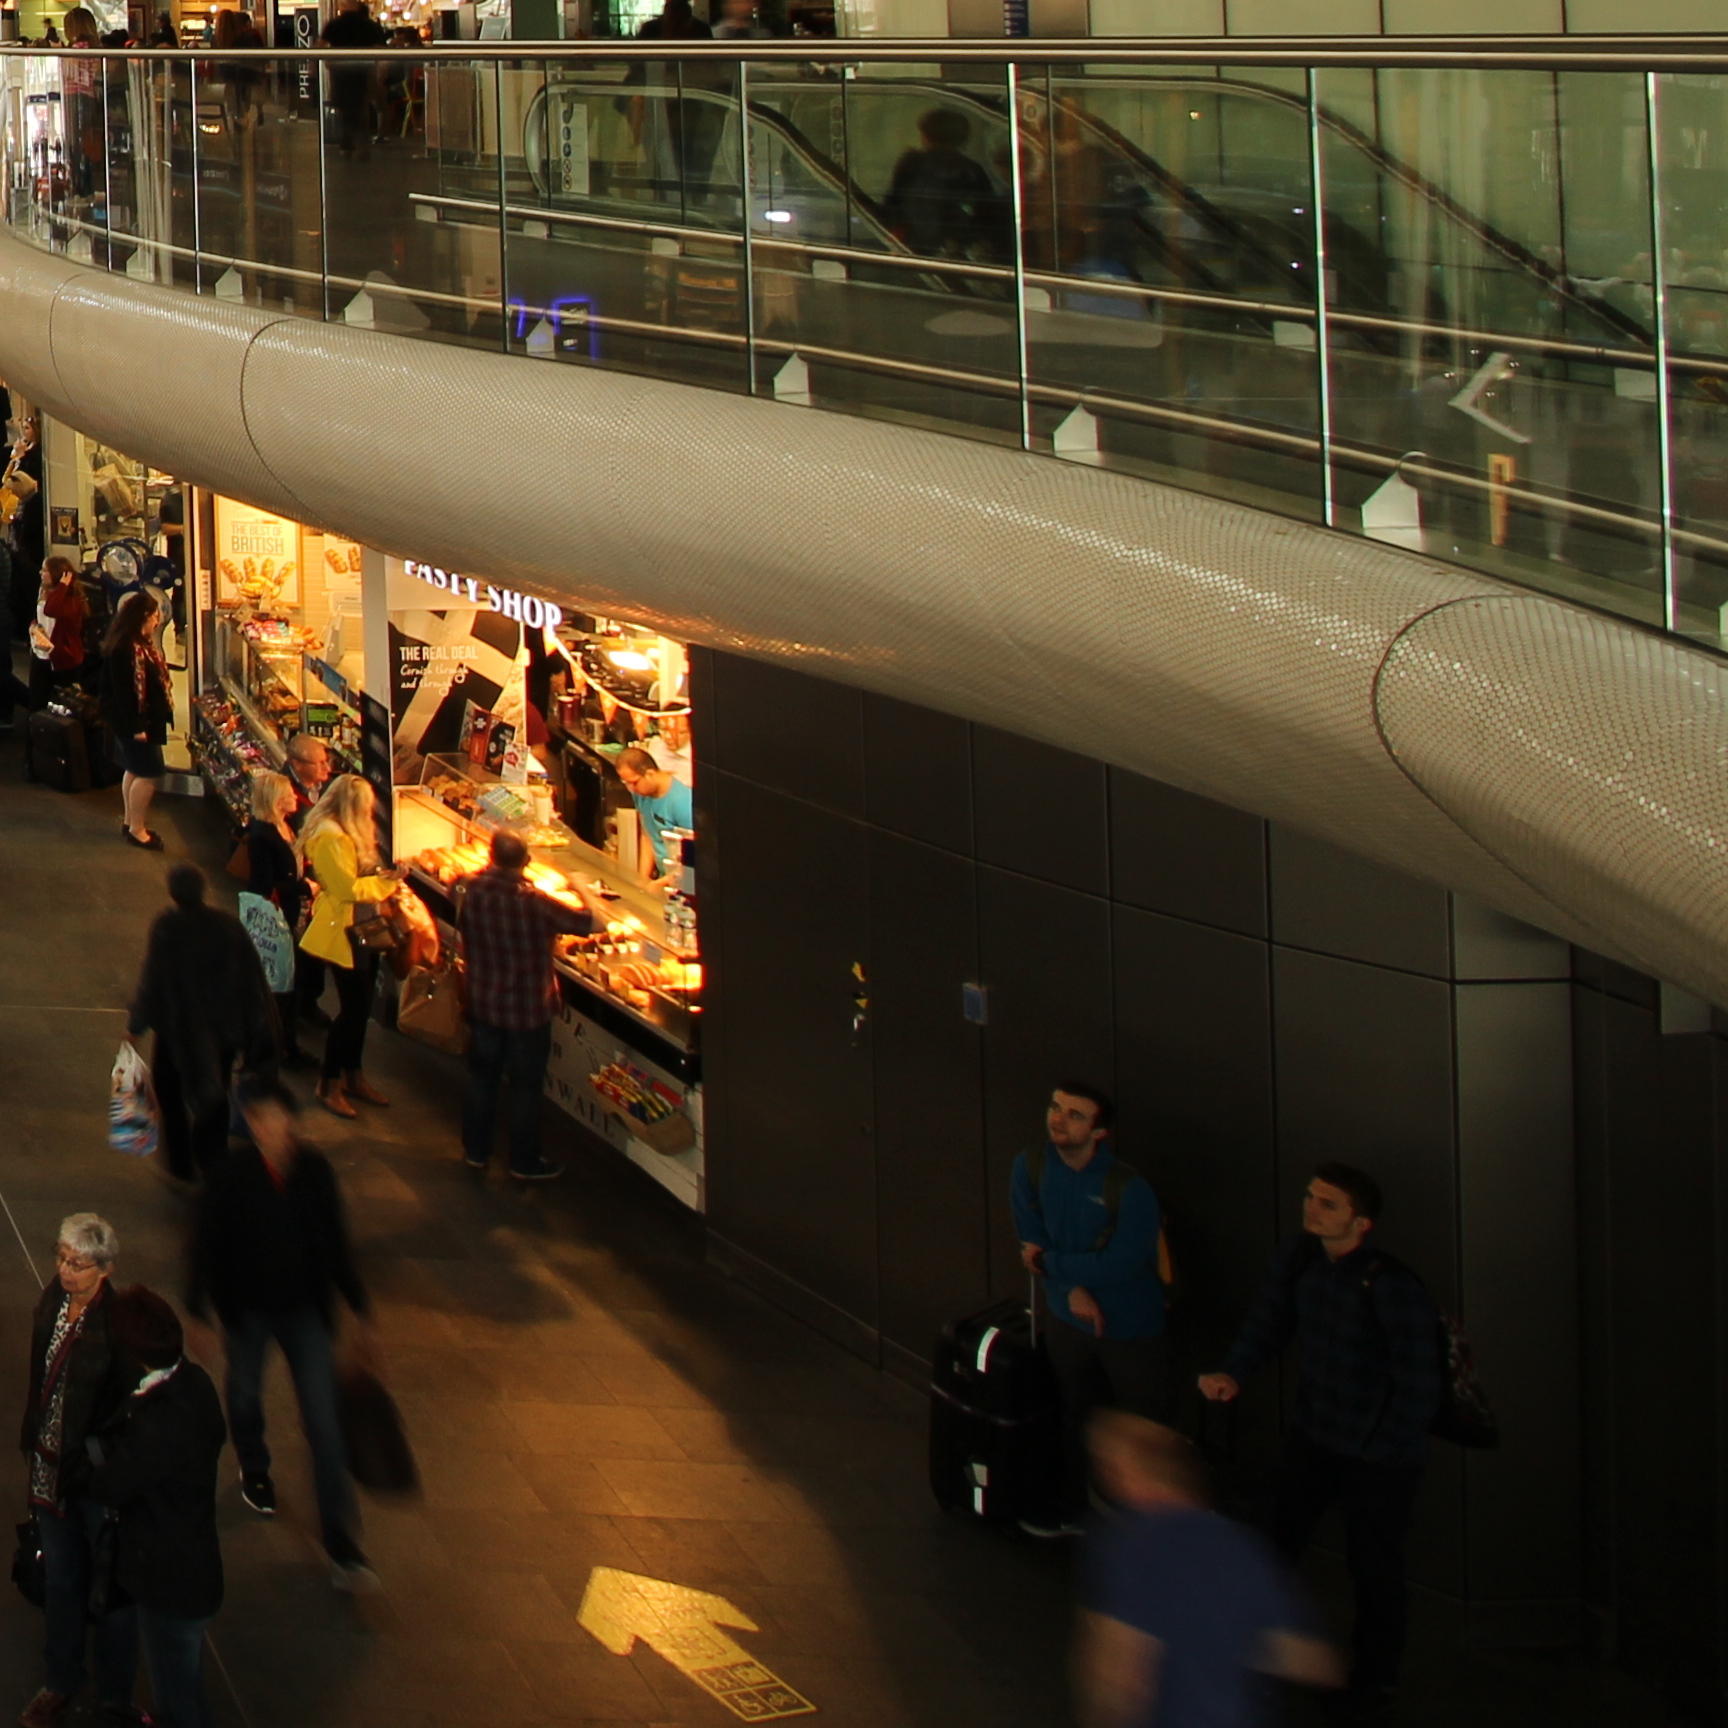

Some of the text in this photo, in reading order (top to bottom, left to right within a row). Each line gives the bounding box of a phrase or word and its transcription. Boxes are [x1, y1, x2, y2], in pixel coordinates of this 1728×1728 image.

[297, 15, 311, 99] PREZO
[231, 535, 284, 554] BRITISH
[486, 584, 563, 632] SHOP
[399, 645, 479, 661] THE REAL DEAL
